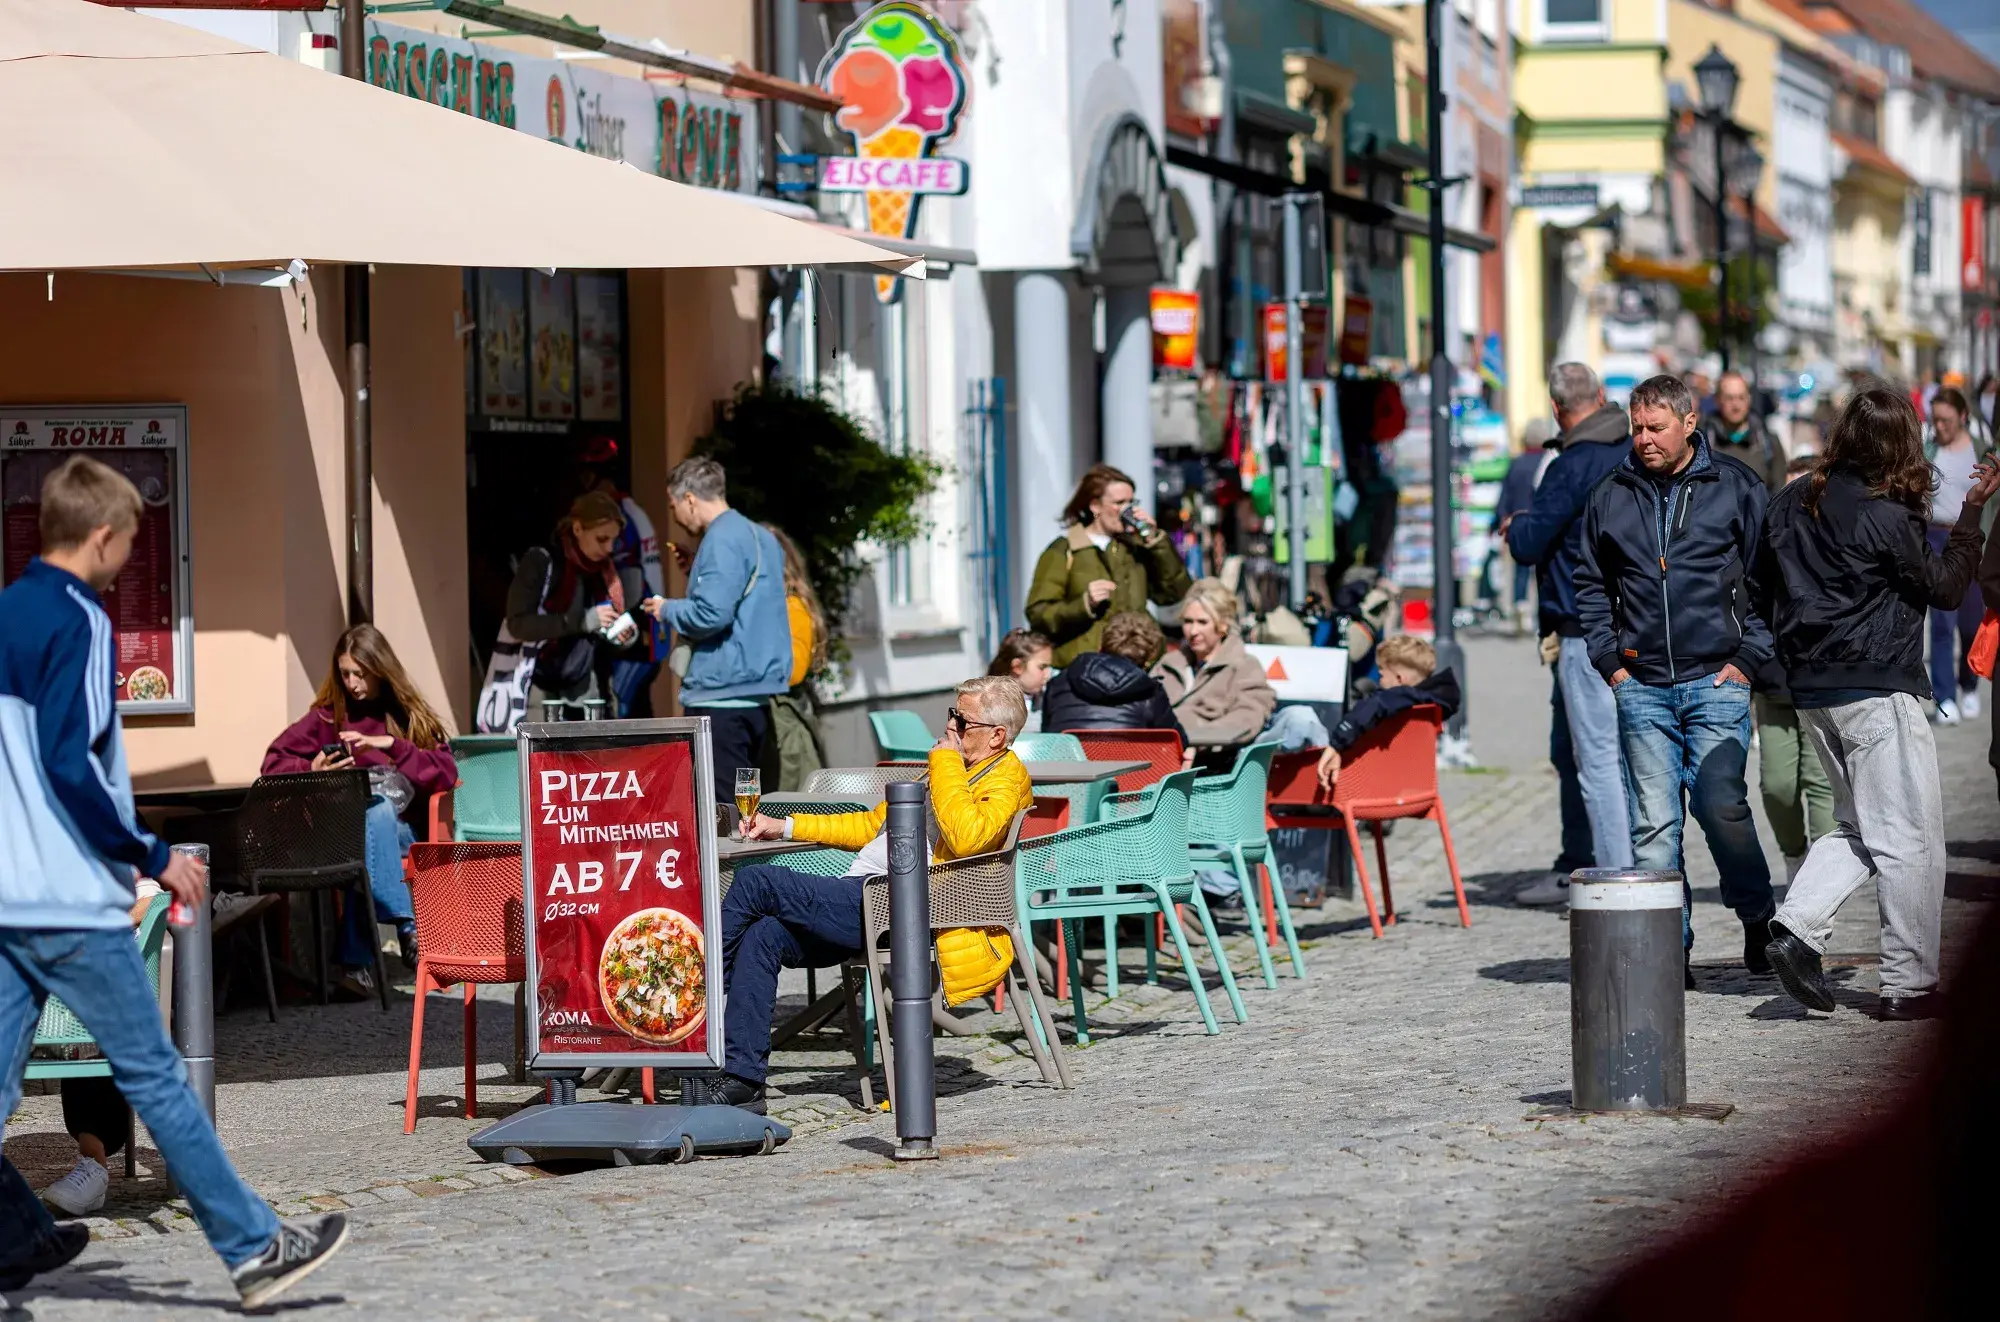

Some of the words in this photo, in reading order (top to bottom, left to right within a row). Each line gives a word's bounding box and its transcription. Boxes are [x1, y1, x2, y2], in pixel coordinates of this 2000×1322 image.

[655, 96, 742, 191] ROMA
[826, 158, 954, 188] EISCAFE
[50, 426, 126, 446] ROMA
[540, 770, 645, 804] PIZZA
[541, 805, 589, 825] ZUM
[560, 821, 680, 845] MITNEHMEN
[546, 861, 604, 896] AB
[615, 849, 643, 891] 7
[655, 848, 684, 889] €
[578, 903, 600, 915] CM
[545, 1011, 593, 1026] ROMA
[553, 1034, 602, 1045] RISTORANTE
